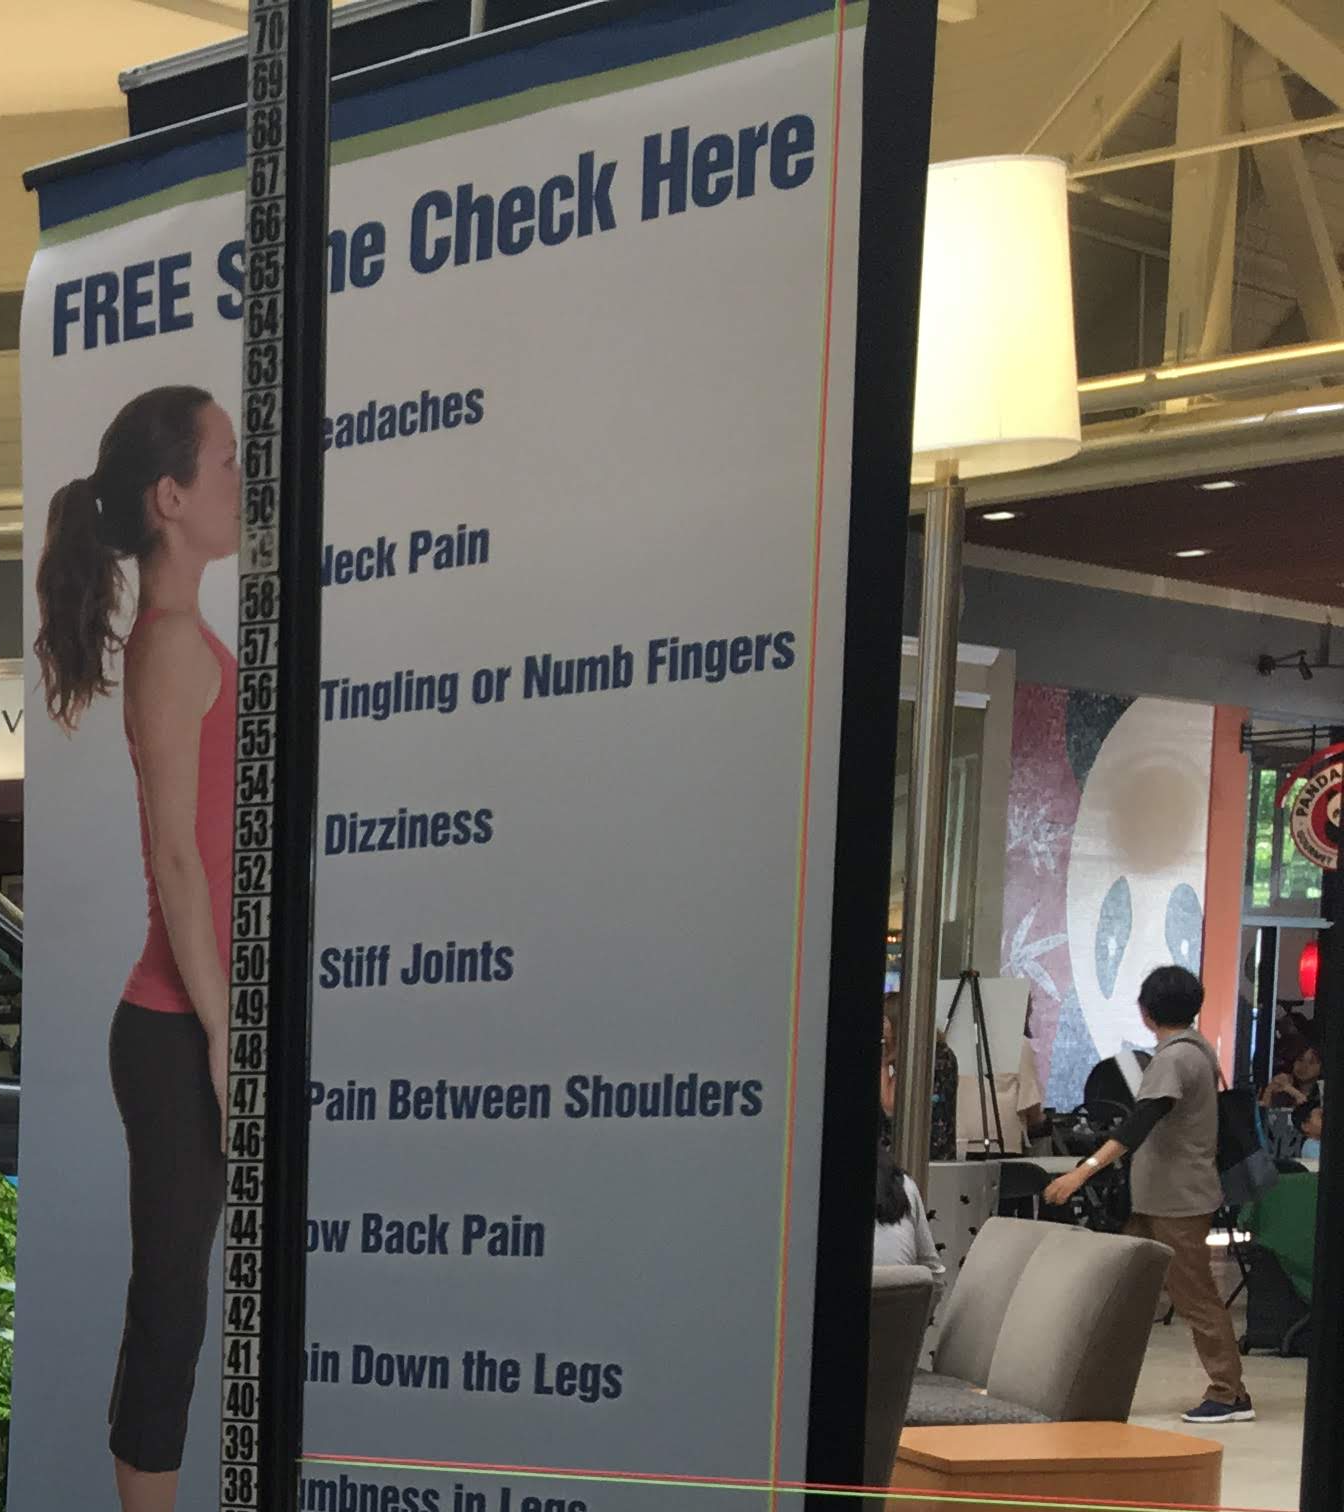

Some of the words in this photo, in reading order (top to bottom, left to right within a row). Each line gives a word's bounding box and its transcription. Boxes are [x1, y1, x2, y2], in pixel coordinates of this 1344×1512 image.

[255, 11, 283, 53] 70
[254, 59, 282, 100] 69
[253, 106, 281, 148] 68
[252, 154, 280, 196] 67
[52, 253, 195, 357] FREE
[217, 222, 386, 320] Sne
[409, 150, 618, 276] Check
[640, 114, 816, 222] Here
[250, 202, 279, 243] 66
[249, 250, 278, 290] 65
[248, 298, 277, 338] 64
[247, 345, 276, 386] 63
[246, 393, 275, 433] 62
[321, 388, 484, 452] eadaches
[246, 440, 274, 480] 61
[408, 524, 490, 574] Pain
[245, 580, 273, 619] 58
[244, 626, 272, 665] 57
[244, 673, 271, 710] 56
[321, 670, 459, 722] Tingling
[472, 664, 512, 705] or
[522, 644, 634, 699] Numb
[647, 630, 795, 683] Fingers
[243, 720, 270, 756] 55
[242, 766, 269, 802] 54
[241, 811, 268, 847] 53
[324, 807, 493, 856] Dizziness
[240, 856, 267, 891] 52
[238, 900, 265, 936] 51
[237, 945, 264, 980] 50
[319, 945, 391, 989] Stiff
[400, 940, 514, 986] Joints
[236, 990, 263, 1025] 49
[235, 1034, 262, 1069] 48
[234, 1078, 260, 1113] 47
[309, 1081, 376, 1122] Pain
[388, 1079, 551, 1121] Between
[564, 1073, 763, 1118] Shoulders
[232, 1122, 259, 1157] 46
[231, 1166, 258, 1201] 45
[230, 1209, 257, 1244] 44
[305, 1219, 350, 1253] ow
[362, 1213, 450, 1255] Back
[462, 1214, 545, 1257] Pain
[229, 1253, 257, 1288] 43
[228, 1296, 256, 1331] 42
[227, 1339, 255, 1374] 41
[352, 1344, 450, 1389] Down
[462, 1350, 520, 1393] the
[534, 1352, 624, 1403] Legs
[226, 1382, 254, 1417] 40
[225, 1424, 252, 1460] 39
[224, 1467, 251, 1503] 38
